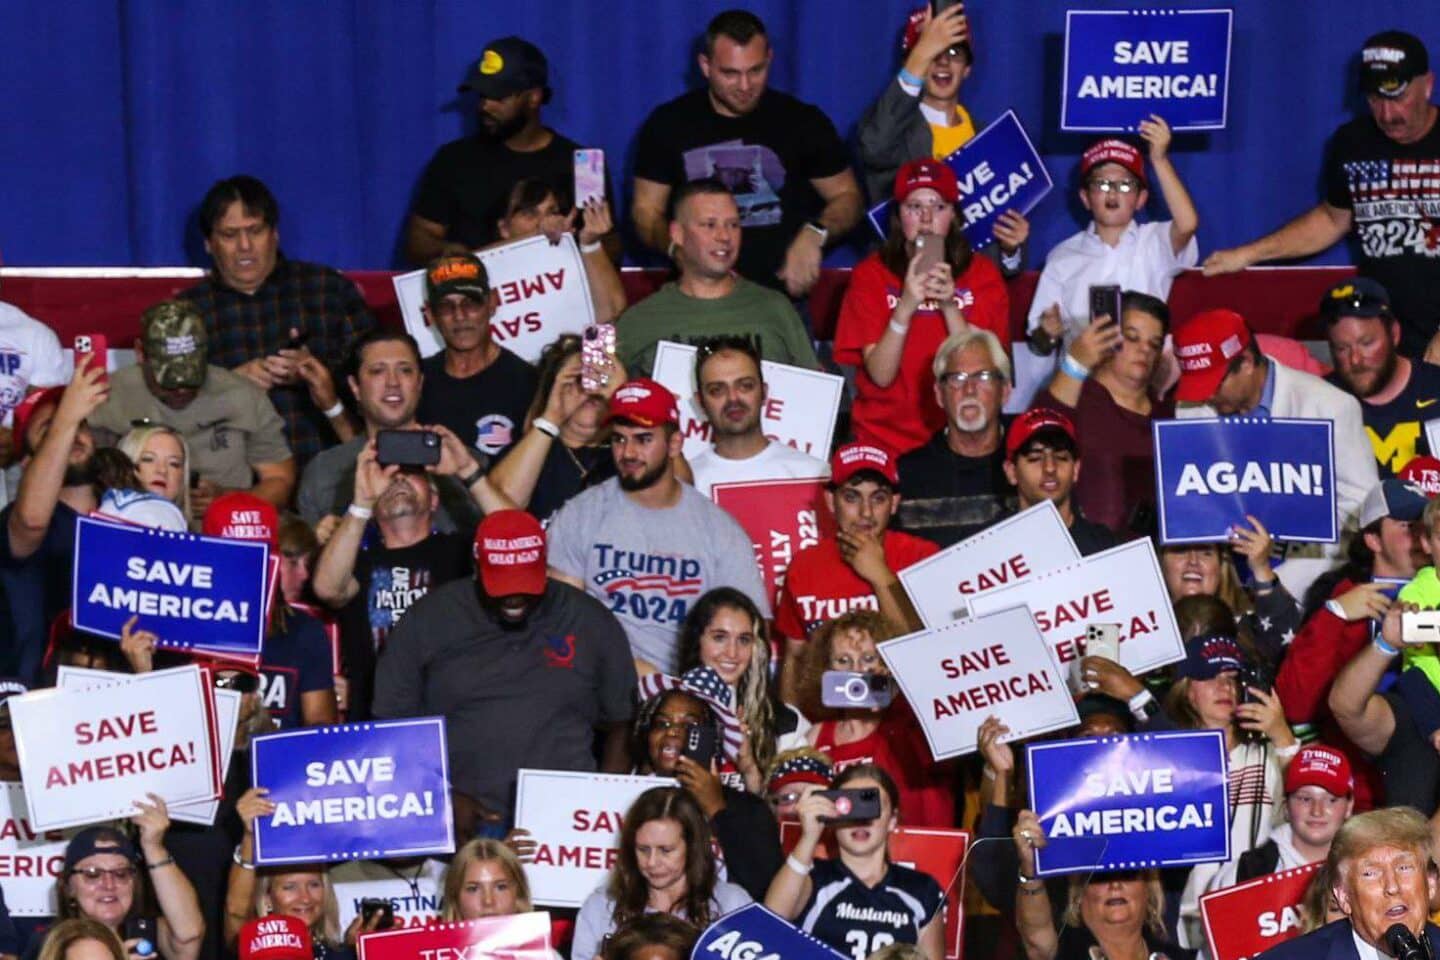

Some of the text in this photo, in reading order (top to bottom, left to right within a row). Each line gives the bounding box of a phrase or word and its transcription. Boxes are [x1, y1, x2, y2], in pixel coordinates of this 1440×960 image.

[1113, 41, 1188, 64] SAVE
[1362, 47, 1405, 63] TRUMP
[1078, 75, 1216, 99] AMERICA!
[959, 161, 996, 197] VE
[965, 161, 1034, 226] RICA!
[489, 311, 543, 342] SAV
[1364, 422, 1422, 474] M
[1176, 461, 1322, 496] AGAIN!
[1409, 470, 1437, 482] LT'S
[221, 525, 271, 538] AMERICA
[231, 511, 260, 524] SAVE
[485, 535, 543, 549] MAKE AMERICA
[126, 556, 214, 589] SAVE
[594, 543, 701, 581] Trump
[957, 554, 1031, 596] SAVE
[88, 584, 249, 623] AMERICA!
[609, 592, 687, 625] 2024
[797, 594, 880, 621] Trum
[1034, 589, 1115, 633] SAVE
[940, 643, 1011, 679] SAVE
[932, 669, 1053, 720] AMERICA!
[75, 711, 158, 745] SAVE
[45, 742, 197, 790] AMERICA!
[306, 757, 395, 787] SAVE
[1086, 768, 1174, 798] SAVE
[270, 790, 434, 828] AMERICA!
[572, 810, 622, 833] SAV
[1048, 803, 1214, 838] AMERICA!
[0, 855, 68, 878] ERIC
[533, 844, 622, 869] AMER
[257, 918, 289, 936] SAVE
[836, 902, 909, 927] Mustangs
[1258, 905, 1302, 937] SA
[249, 930, 302, 951] AMERICA
